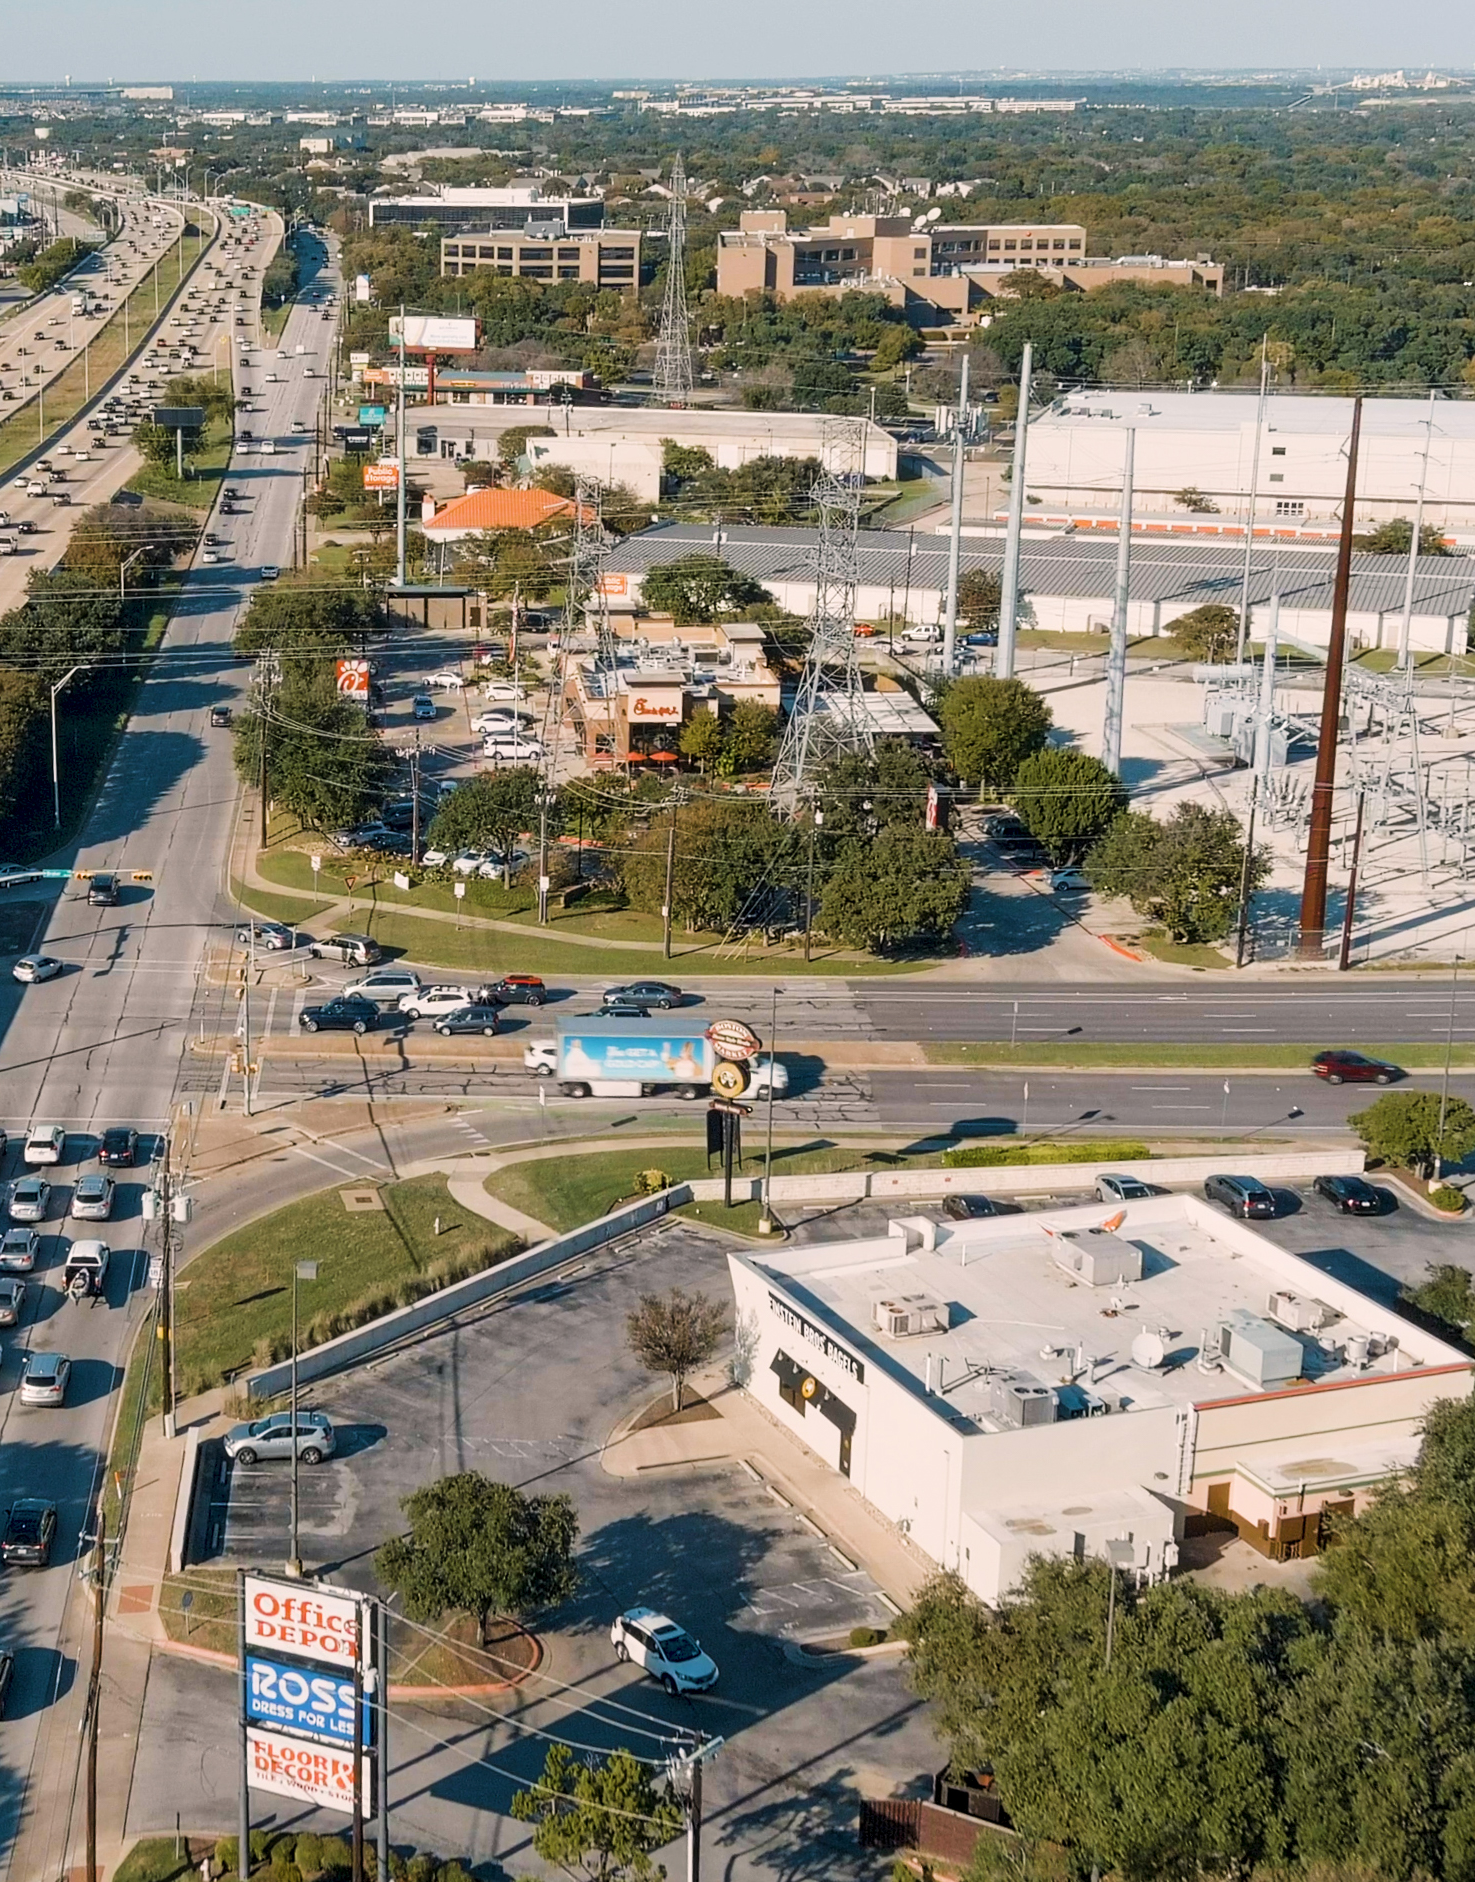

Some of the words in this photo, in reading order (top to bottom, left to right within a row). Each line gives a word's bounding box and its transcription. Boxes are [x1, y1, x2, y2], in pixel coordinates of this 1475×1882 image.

[365, 474, 396, 484] Storage
[368, 467, 393, 475] Public
[716, 1022, 748, 1038] BOSTON
[714, 1042, 747, 1058] MARKET
[770, 1299, 802, 1335] EINSTEIN
[828, 1341, 858, 1379] BAGELS
[252, 1662, 355, 1721] ROSS
[252, 1698, 294, 1720] DRESS
[298, 1710, 325, 1729] FOR
[330, 1718, 355, 1736] LES
[254, 1740, 328, 1770] FLOOR
[254, 1756, 328, 1788] DECOR
[256, 1771, 276, 1783] TILE
